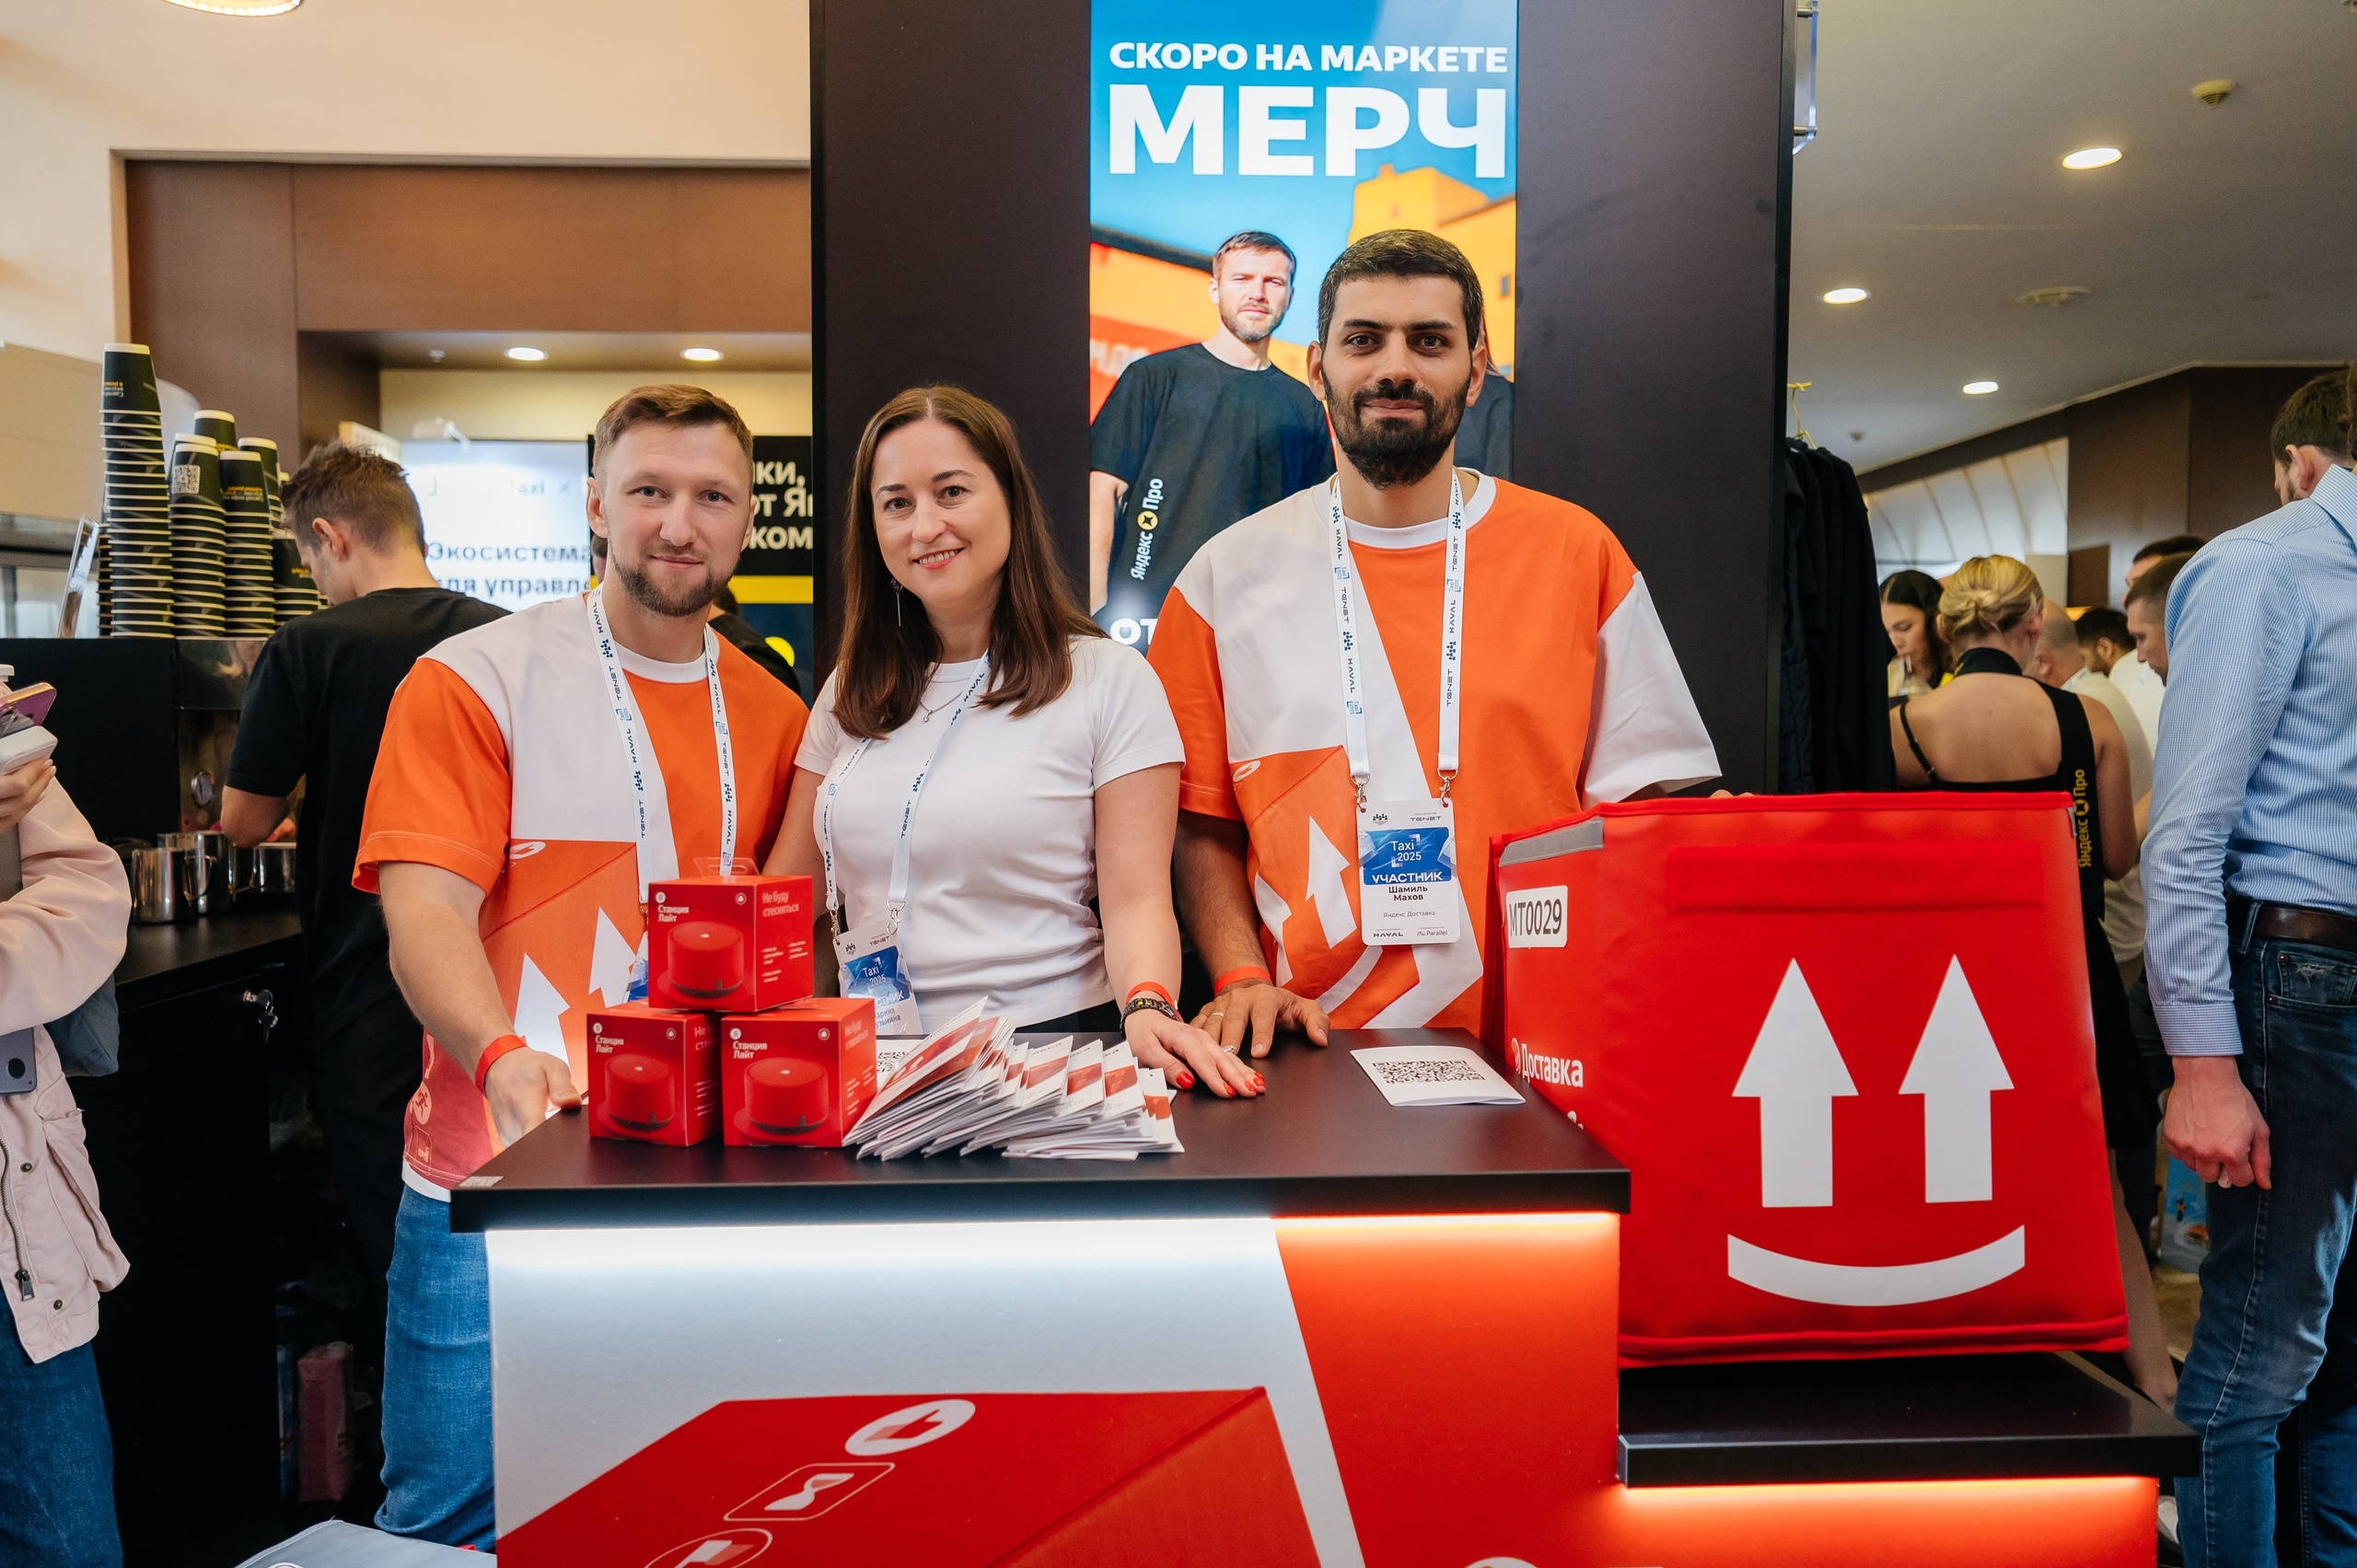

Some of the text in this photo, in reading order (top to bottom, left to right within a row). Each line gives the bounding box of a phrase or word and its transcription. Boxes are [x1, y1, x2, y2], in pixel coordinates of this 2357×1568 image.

[1109, 41, 1508, 73] СКОРО НА МАРКЕТЕ
[1109, 84, 1506, 179] МЕРЧ
[1130, 478, 1164, 581] Яндекс Про
[429, 541, 590, 563] Экосистема
[439, 577, 477, 593] ля
[1341, 587, 1350, 623] TENET
[592, 602, 604, 633] HAVAL
[609, 666, 622, 701] TENET
[1347, 657, 1355, 693] HAVAL
[963, 673, 985, 703] HAVAL
[714, 683, 722, 715] HAVAL
[626, 728, 637, 763] HAVAL
[722, 741, 730, 776] TENET
[900, 799, 912, 839] TENET
[2073, 769, 2093, 867] Яндекс Про
[1390, 839, 1415, 851] Taxi
[1397, 852, 1422, 862] 2025
[1372, 871, 1444, 884] УЧАСТНИК
[1388, 885, 1428, 894] Шамиль
[657, 904, 690, 914] Станция
[657, 913, 678, 923] Лайт
[1509, 898, 1562, 937] MT0029
[863, 964, 879, 978] Taxi
[869, 974, 887, 987] 2025
[875, 990, 905, 1007] СТНИК
[875, 1007, 896, 1019] арина
[876, 1015, 901, 1028] узьмина
[596, 1035, 624, 1046] Станция
[596, 1043, 613, 1053] Лайт
[733, 1040, 768, 1051] Станция
[734, 1050, 755, 1059] Лайт
[1522, 1043, 1584, 1088] Доставка
